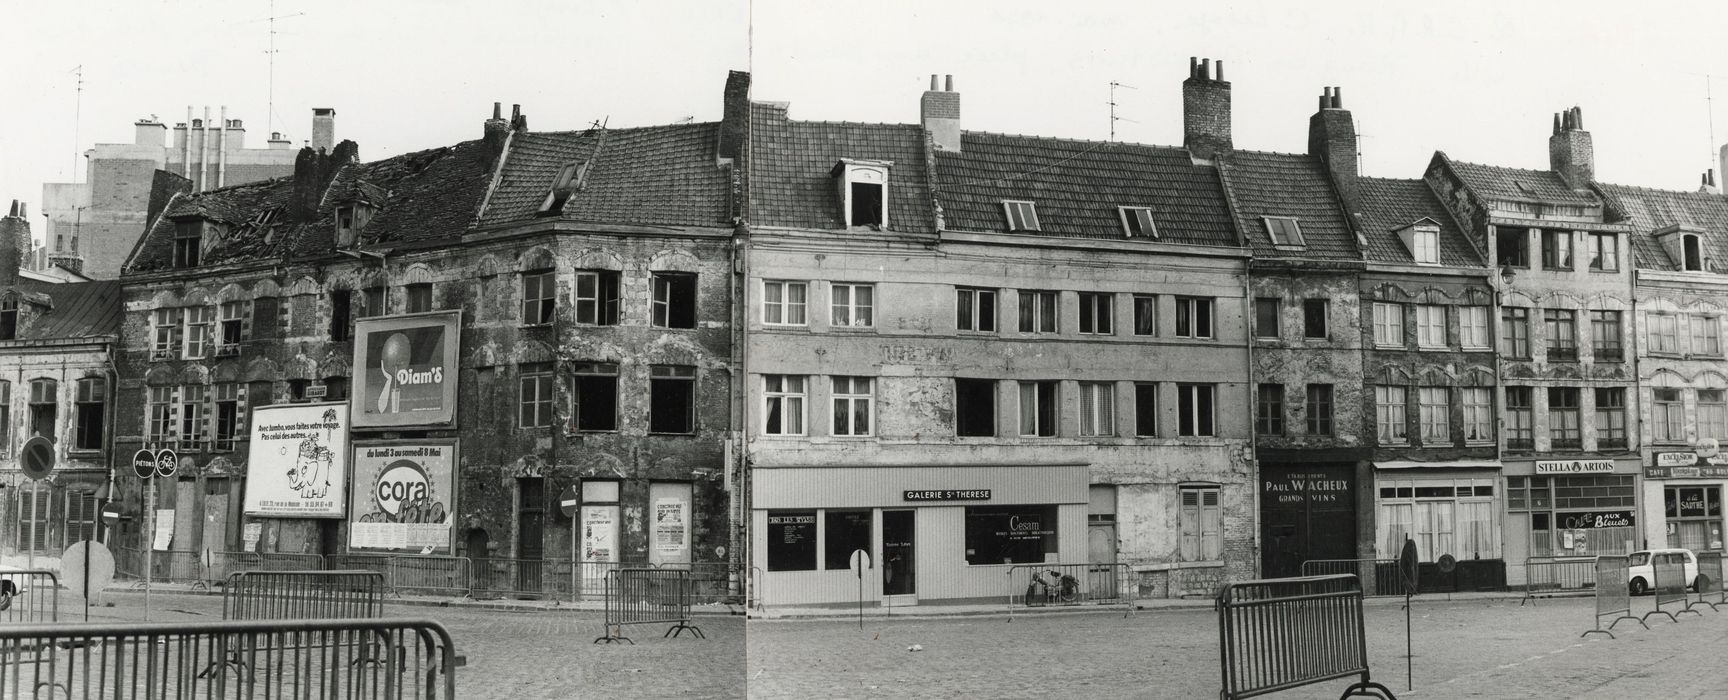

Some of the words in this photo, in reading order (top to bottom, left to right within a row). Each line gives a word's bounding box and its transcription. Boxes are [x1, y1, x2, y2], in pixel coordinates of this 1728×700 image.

[367, 449, 374, 457] du
[375, 448, 389, 457] lundi
[390, 448, 394, 456] 3
[402, 447, 423, 456] samedi
[424, 448, 428, 456] 8
[429, 447, 441, 456] Mai
[1663, 453, 1693, 461] EXCELSIOR
[1538, 463, 1570, 472] STELLA
[1583, 462, 1613, 471] ARTOIS
[378, 481, 427, 501] cora
[907, 491, 942, 499] GALERIE
[1311, 494, 1336, 502] VINS
[1010, 515, 1039, 531] Cesam
[1595, 515, 1628, 527] Bleuets
